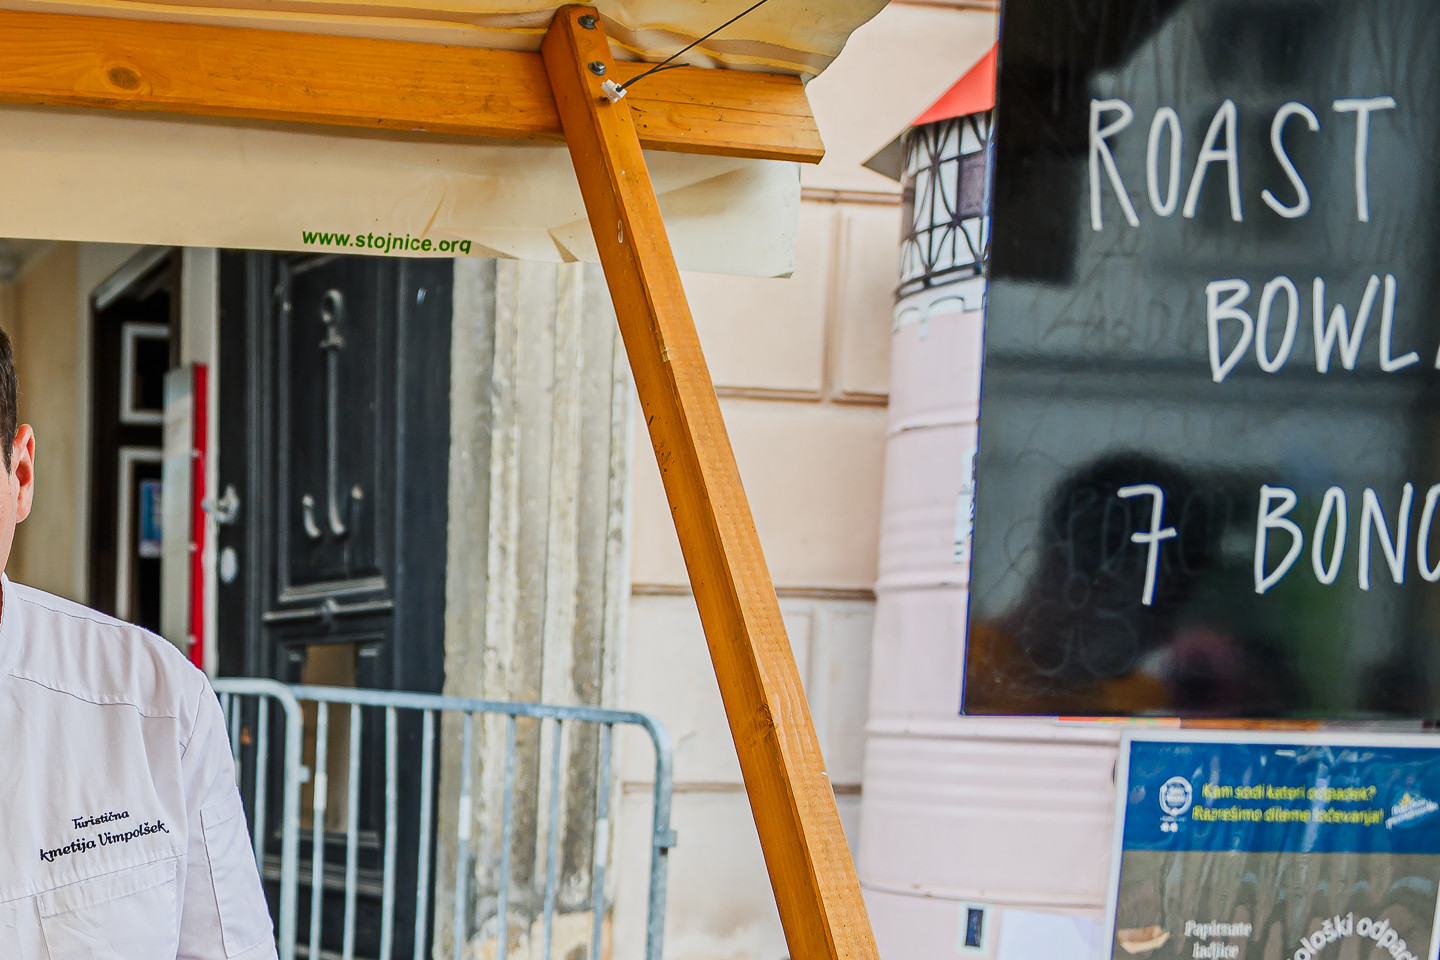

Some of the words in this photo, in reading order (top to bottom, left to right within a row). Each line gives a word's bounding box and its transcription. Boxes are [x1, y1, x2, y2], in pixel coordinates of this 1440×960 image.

[1089, 96, 1396, 231] ROAST
[301, 231, 472, 254] www.stojnice.org
[1205, 273, 1440, 383] BOWL
[1117, 484, 1177, 605] 7
[1202, 783, 1233, 799] Kam
[1234, 783, 1265, 800] sodi
[1266, 783, 1306, 800] kateri
[71, 810, 130, 829] Turistična
[1192, 804, 1263, 822] Razrešimo
[1263, 806, 1311, 822] dileme
[39, 838, 96, 862] kmetija
[97, 819, 169, 846] Vimpolšek
[1184, 920, 1252, 941] Papirnate
